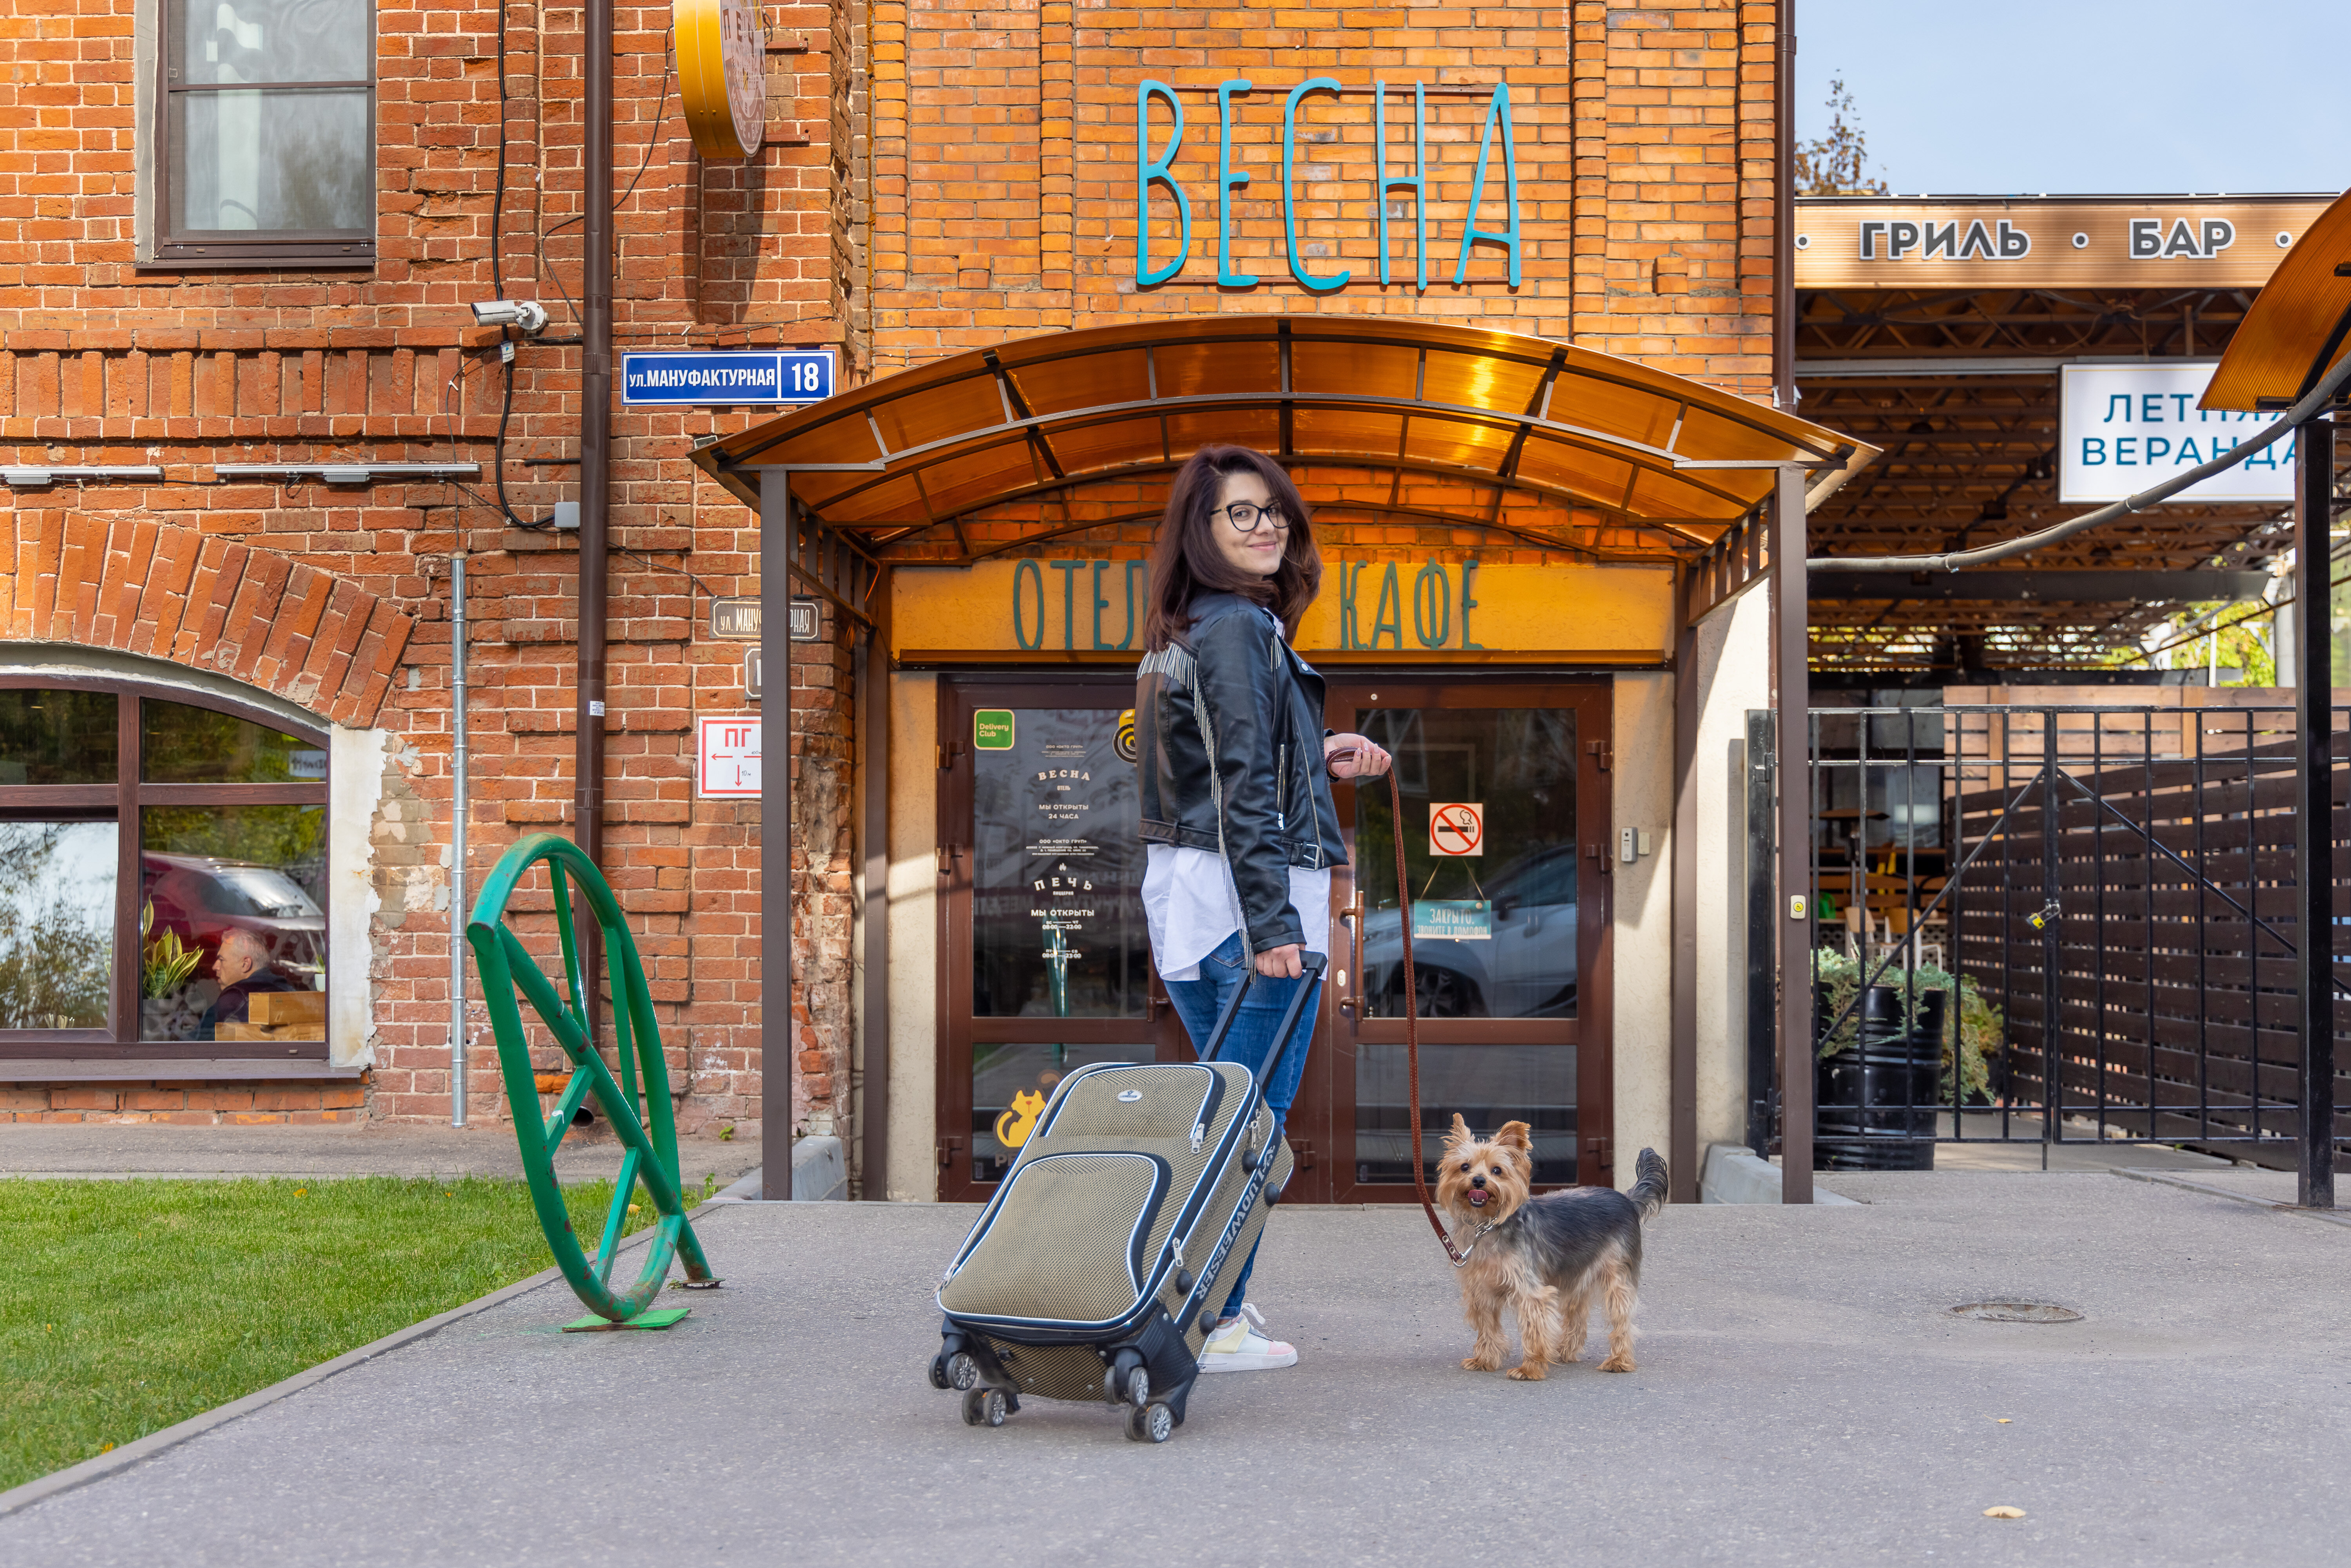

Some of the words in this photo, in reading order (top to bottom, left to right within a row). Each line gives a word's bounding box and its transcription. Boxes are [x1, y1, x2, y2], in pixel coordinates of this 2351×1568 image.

[1137, 77, 1521, 290] ВЕСНА
[1860, 219, 2030, 259] ГРИЛЬ
[2129, 218, 2235, 259] БАР
[792, 362, 819, 391] 18
[1013, 559, 1150, 650] ОТЕЛ
[1340, 557, 1483, 650] КАФЕ
[725, 728, 751, 746] ПГ
[980, 723, 1009, 731] Delivery
[1038, 770, 1090, 781] ВЕСНА
[1034, 877, 1092, 891] ПЕЧЬ
[1417, 925, 1445, 934] ЗВОНИТЕ
[1195, 1168, 1266, 1300] LUOWEESER
